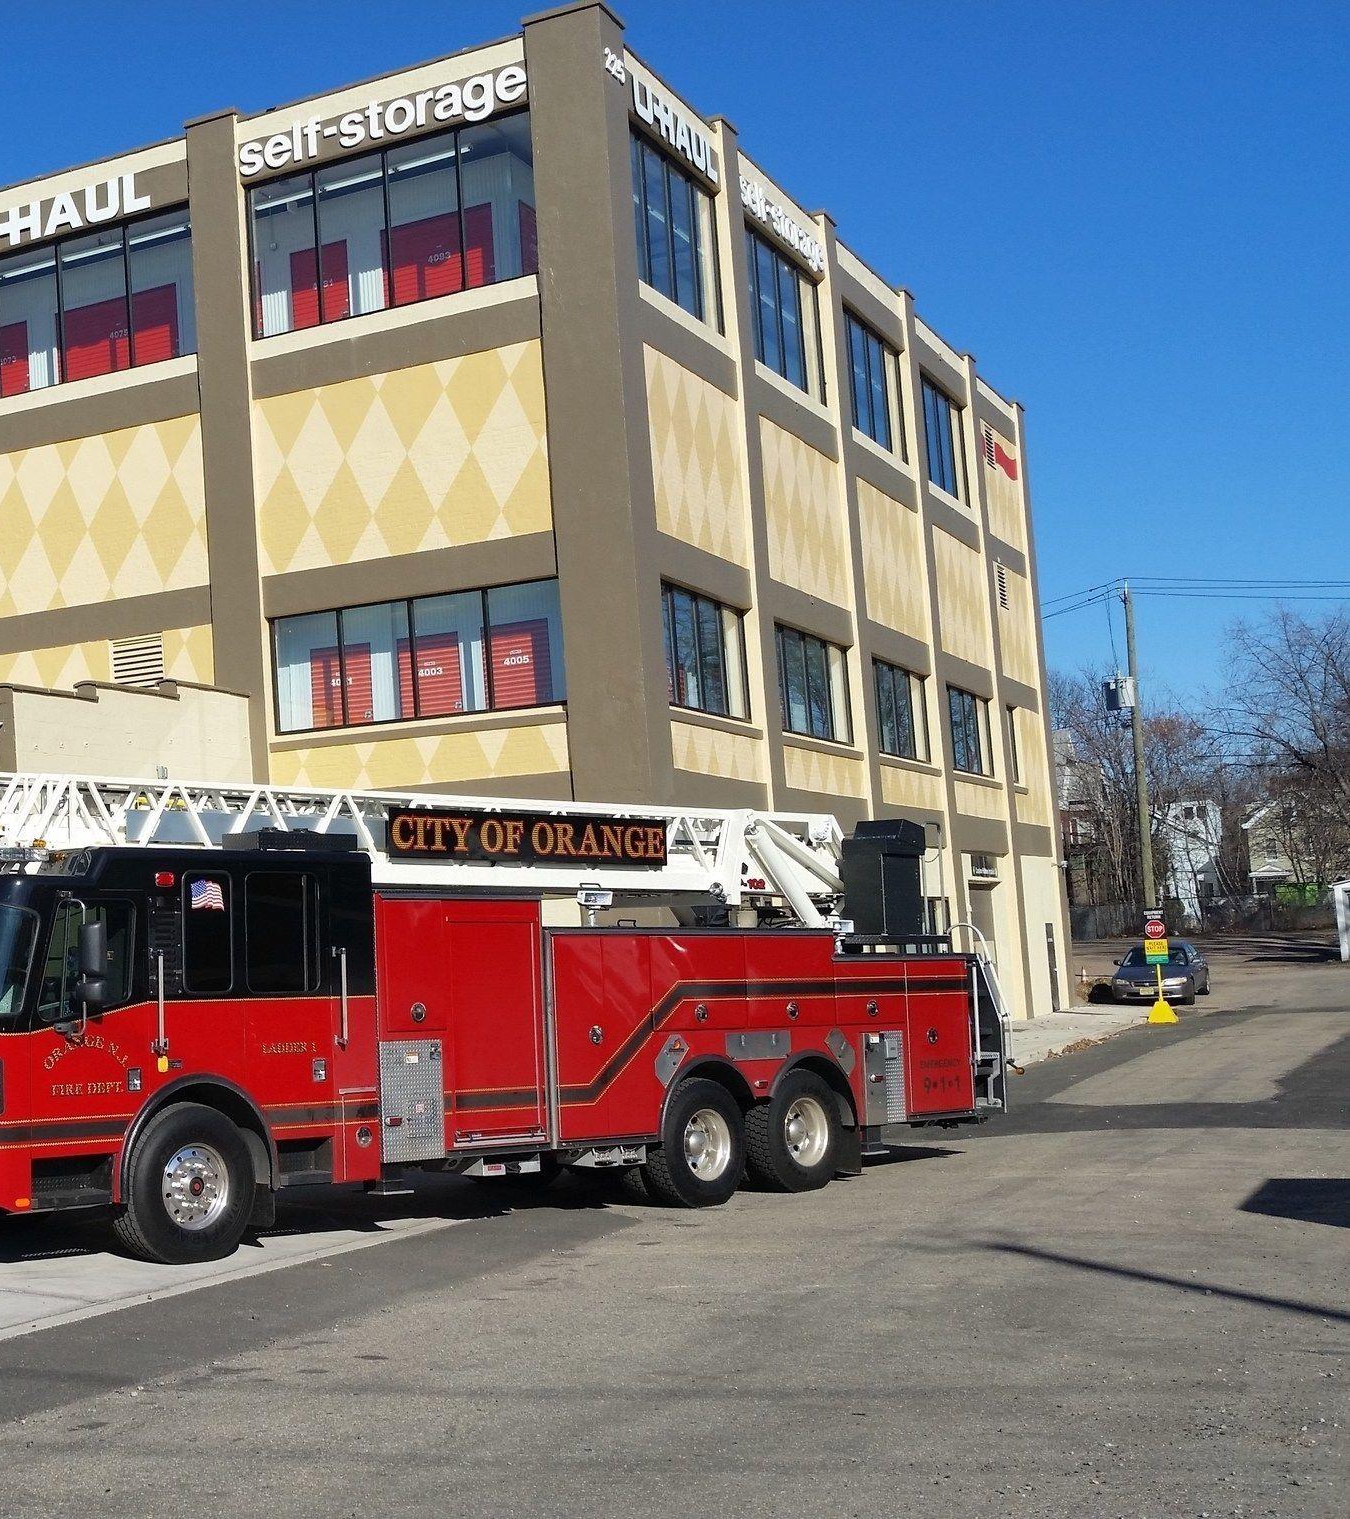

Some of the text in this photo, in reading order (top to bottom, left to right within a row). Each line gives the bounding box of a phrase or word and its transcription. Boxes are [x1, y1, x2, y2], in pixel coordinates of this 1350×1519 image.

[238, 66, 527, 178] self-storage
[630, 70, 719, 184] U-HAUL
[738, 174, 825, 272] self-storage
[503, 655, 530, 666] 4005
[417, 667, 443, 677] 4003
[331, 677, 353, 687] 401
[391, 815, 666, 858] CITY OF ORANGE
[1147, 925, 1163, 933] STOP
[51, 1084, 83, 1096] FIRE
